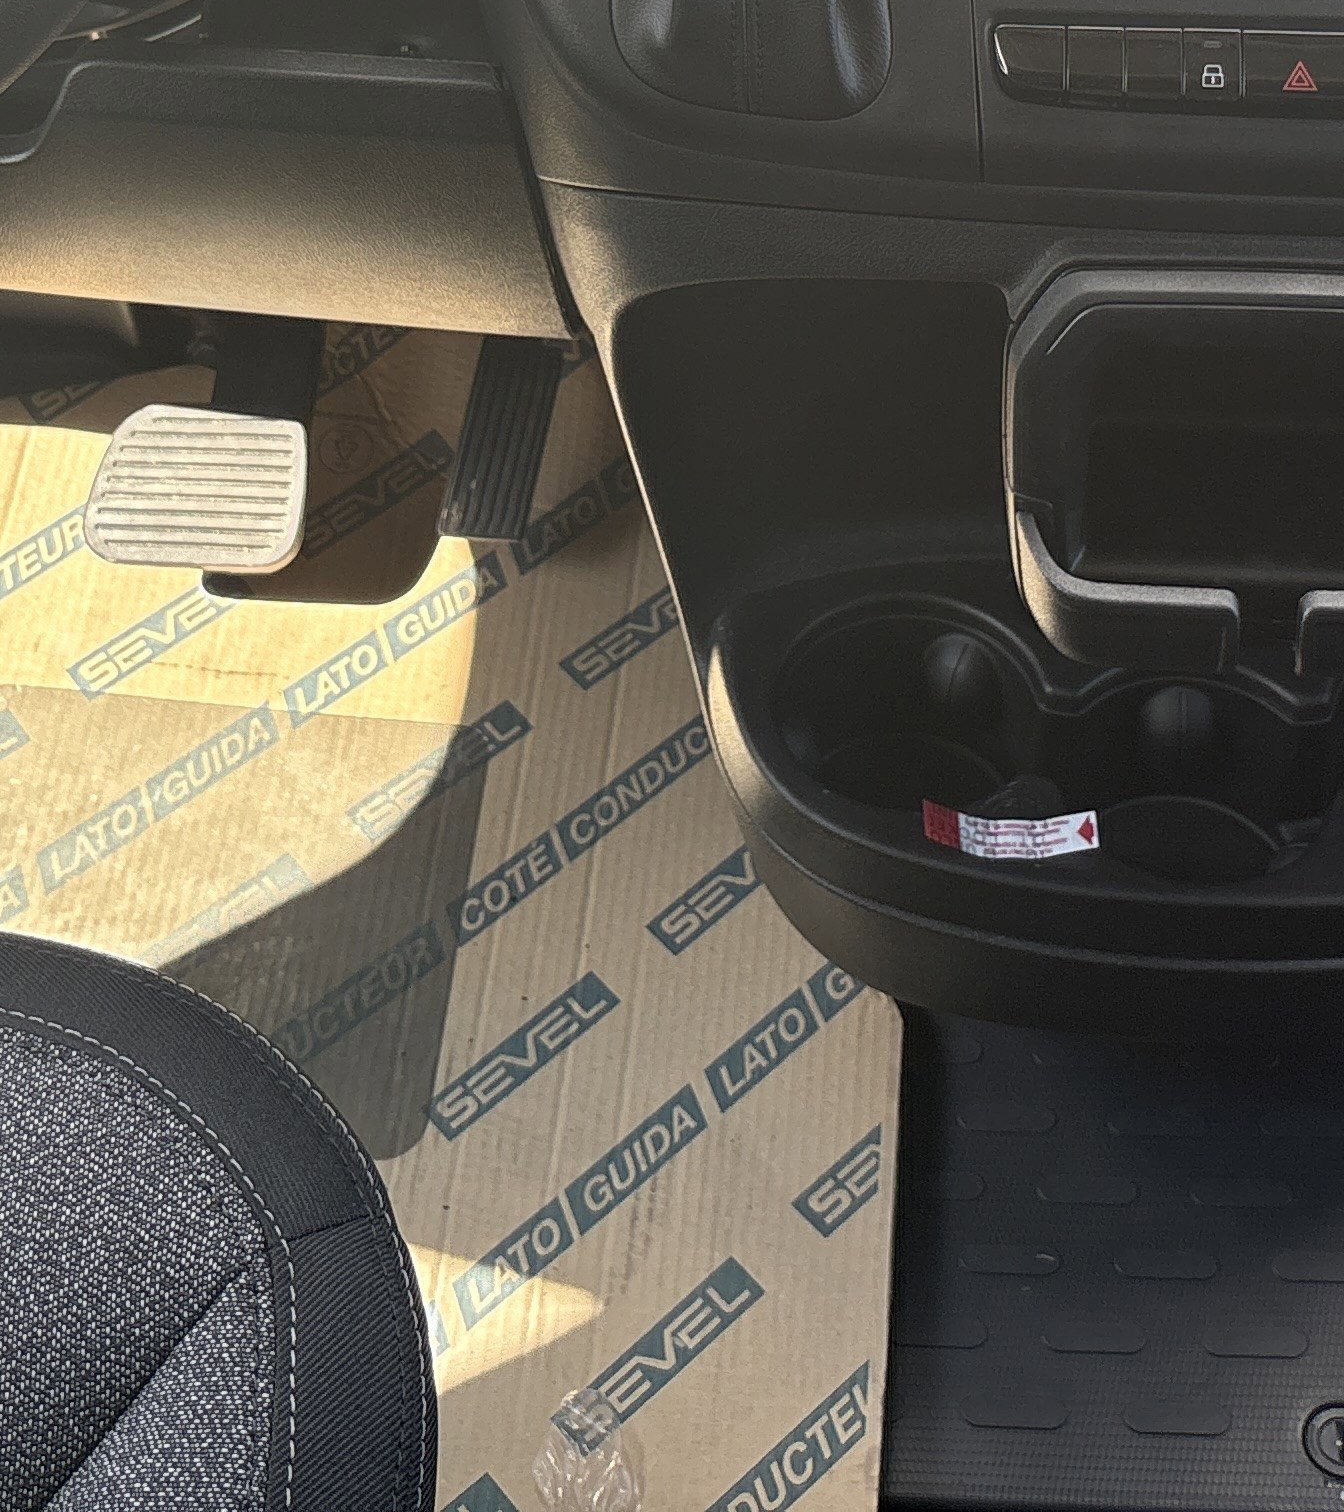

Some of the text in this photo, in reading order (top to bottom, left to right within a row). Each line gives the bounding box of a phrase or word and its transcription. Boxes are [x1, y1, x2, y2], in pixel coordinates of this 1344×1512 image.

[523, 497, 596, 561] LATO
[292, 567, 498, 716] LATO GUIDA
[573, 594, 681, 681] SEVE
[50, 718, 274, 877] LATO GUIDA
[460, 726, 711, 934] COTÉ CONDUC
[660, 851, 756, 946] SEV
[434, 987, 610, 1125] SEVEL
[718, 1007, 807, 1097] LATO
[468, 1223, 563, 1315] LATO
[583, 1106, 697, 1213] GUIDA
